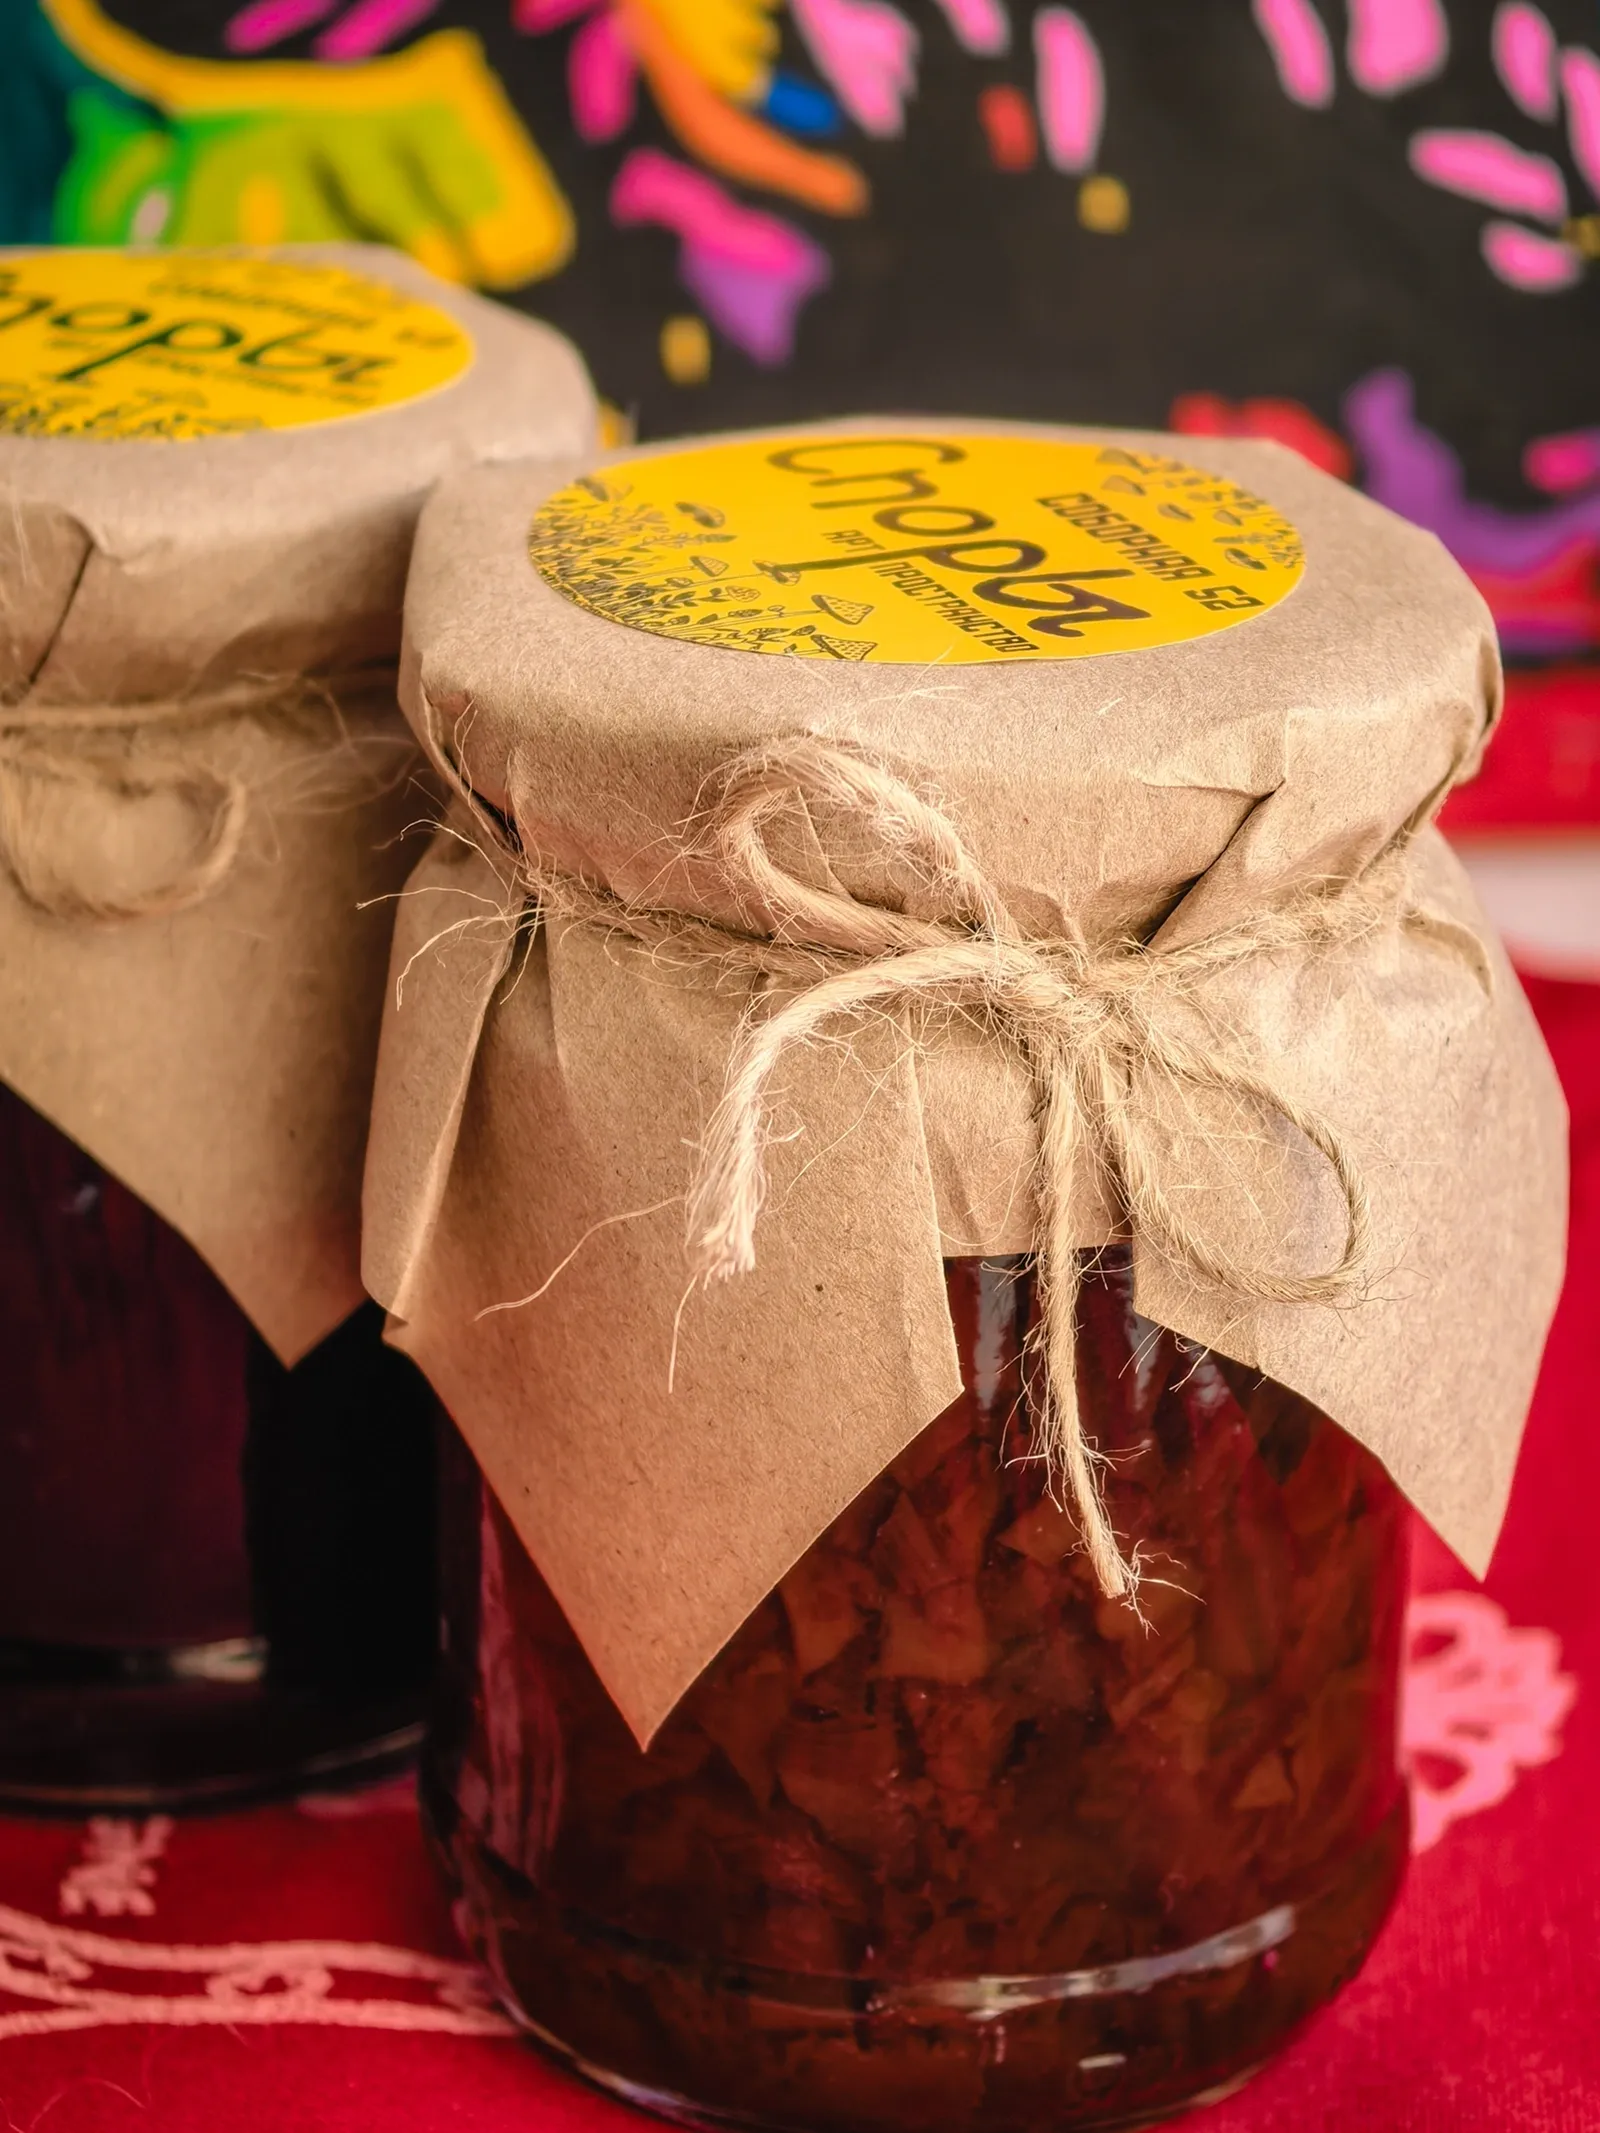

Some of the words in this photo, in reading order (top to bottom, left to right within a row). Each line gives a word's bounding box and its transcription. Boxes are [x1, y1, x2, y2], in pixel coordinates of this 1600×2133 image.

[821, 529, 886, 553] АРТ
[868, 561, 1040, 653] ПРОСТРАНСТВО
[1036, 493, 1216, 582] СОБОРНАЯ
[1183, 585, 1266, 612] 52
